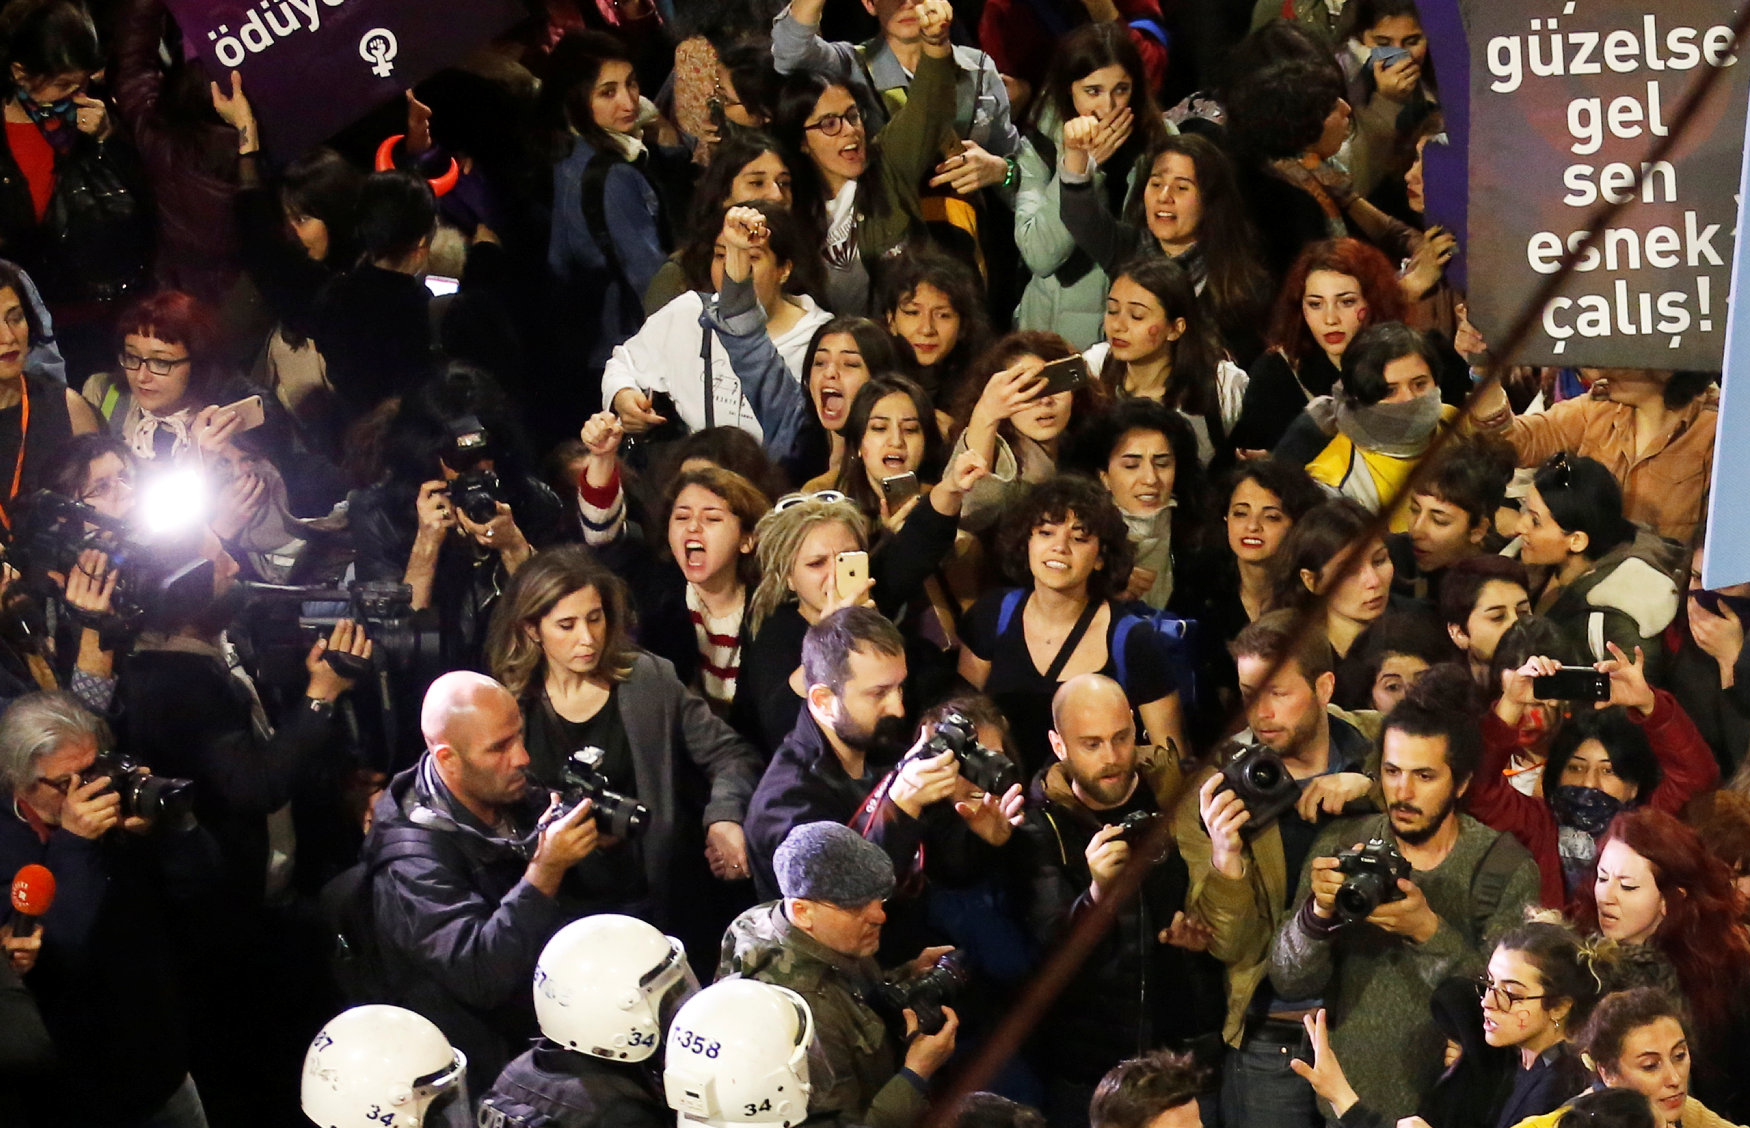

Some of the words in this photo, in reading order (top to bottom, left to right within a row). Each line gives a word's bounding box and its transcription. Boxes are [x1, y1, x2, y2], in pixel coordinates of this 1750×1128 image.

[207, 0, 345, 67] ödüy
[1487, 14, 1738, 93] güzelse
[1567, 81, 1668, 155] gel
[1563, 160, 1677, 207] sen
[1527, 211, 1723, 273] esnek
[1542, 276, 1711, 354] çalış!
[628, 1032, 655, 1048] 34
[744, 1098, 772, 1117] 34
